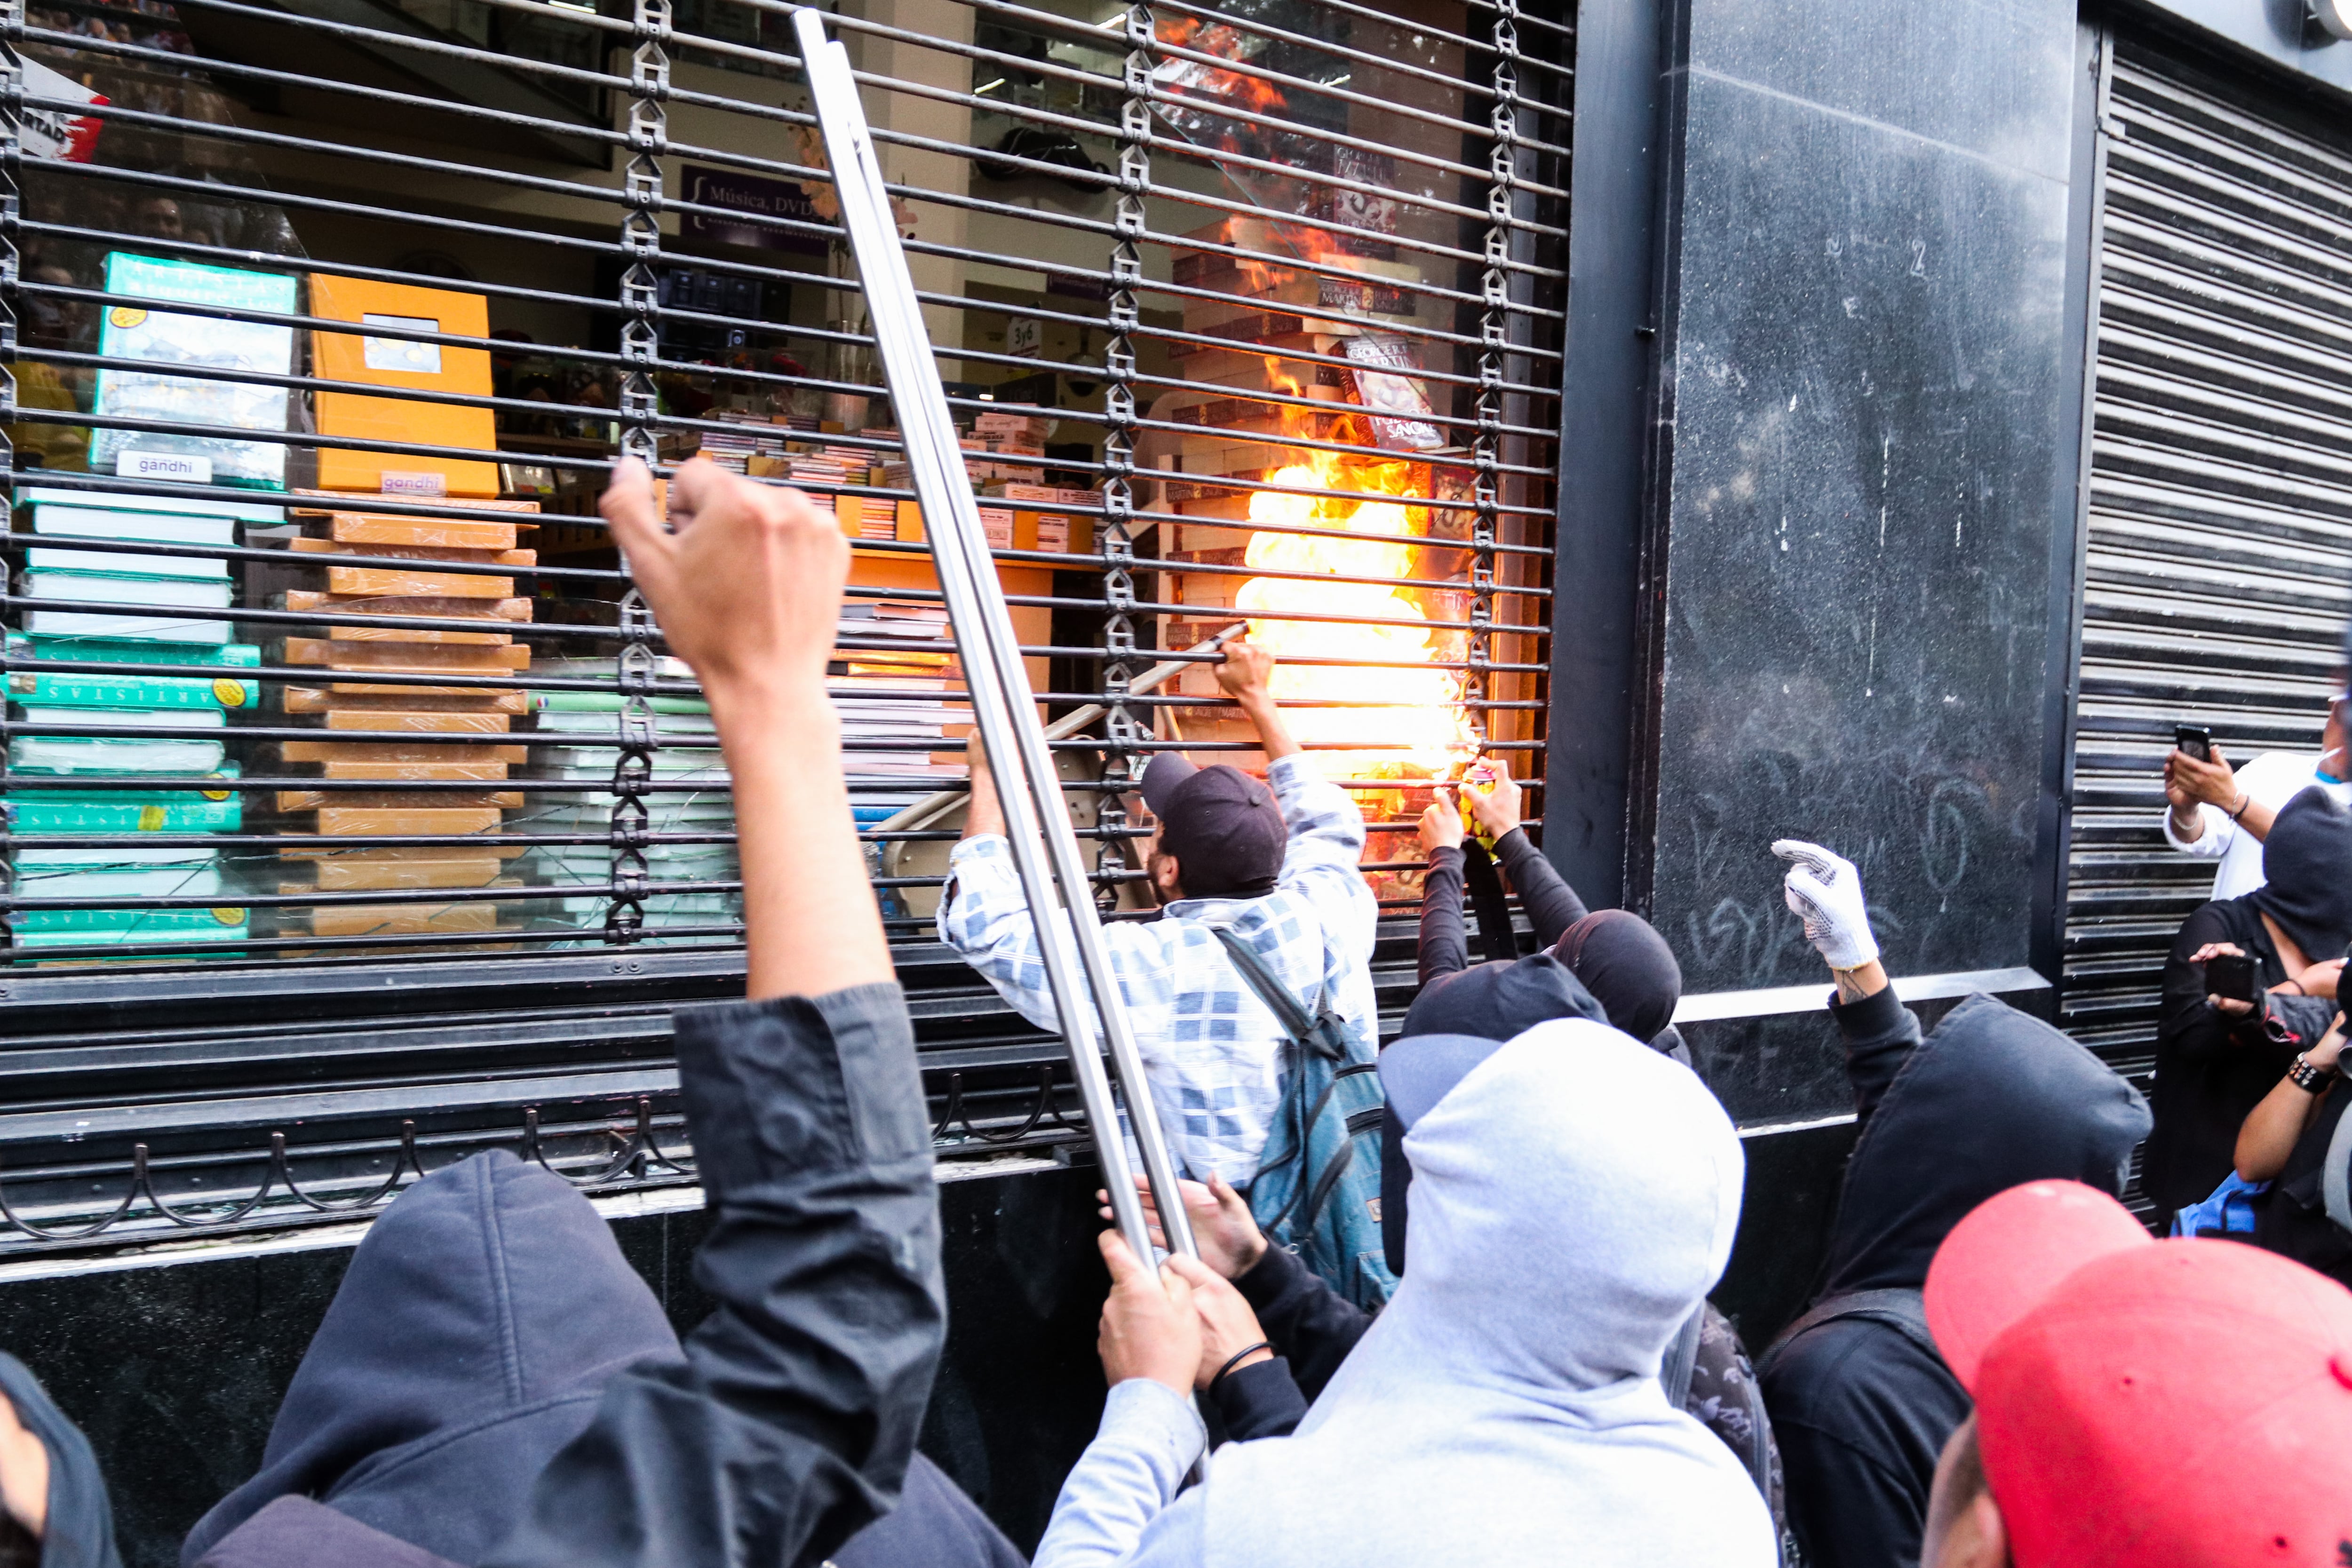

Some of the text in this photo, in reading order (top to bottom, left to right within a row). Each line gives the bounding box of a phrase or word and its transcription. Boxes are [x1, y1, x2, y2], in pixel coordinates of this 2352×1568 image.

[710, 186, 770, 211] Música,
[1015, 324, 1033, 347] 3y6
[139, 460, 192, 473] gandhi
[384, 476, 439, 490] gandhi
[48, 686, 210, 703] ARTISTAS
